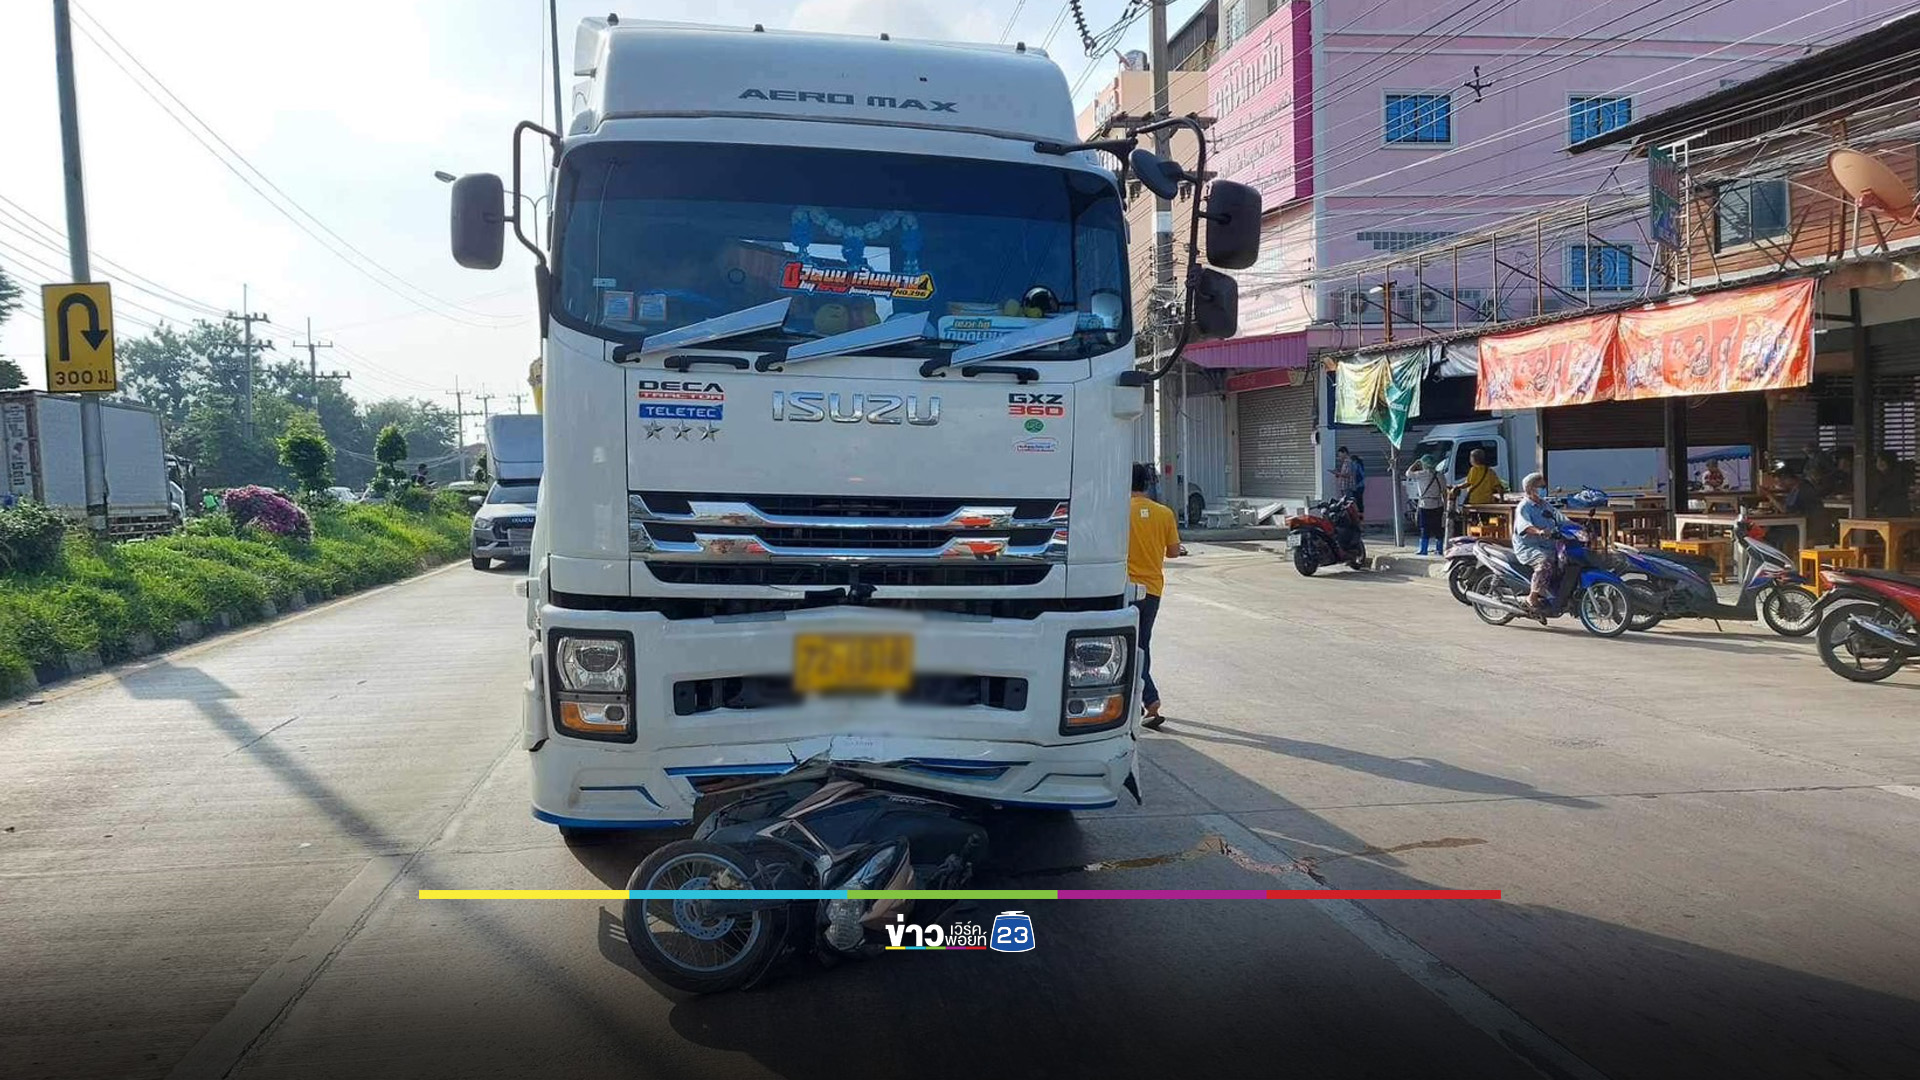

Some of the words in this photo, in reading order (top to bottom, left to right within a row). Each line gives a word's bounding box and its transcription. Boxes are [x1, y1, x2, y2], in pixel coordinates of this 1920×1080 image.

[738, 88, 855, 105] AERO
[867, 95, 960, 113] MAX
[55, 370, 93, 385] 300
[639, 380, 724, 392] DECA
[640, 392, 723, 400] TRACTOR
[1008, 393, 1064, 405] GXZ
[645, 406, 717, 418] TELETEC
[772, 391, 941, 426] ISUZU
[1008, 405, 1064, 416] 360
